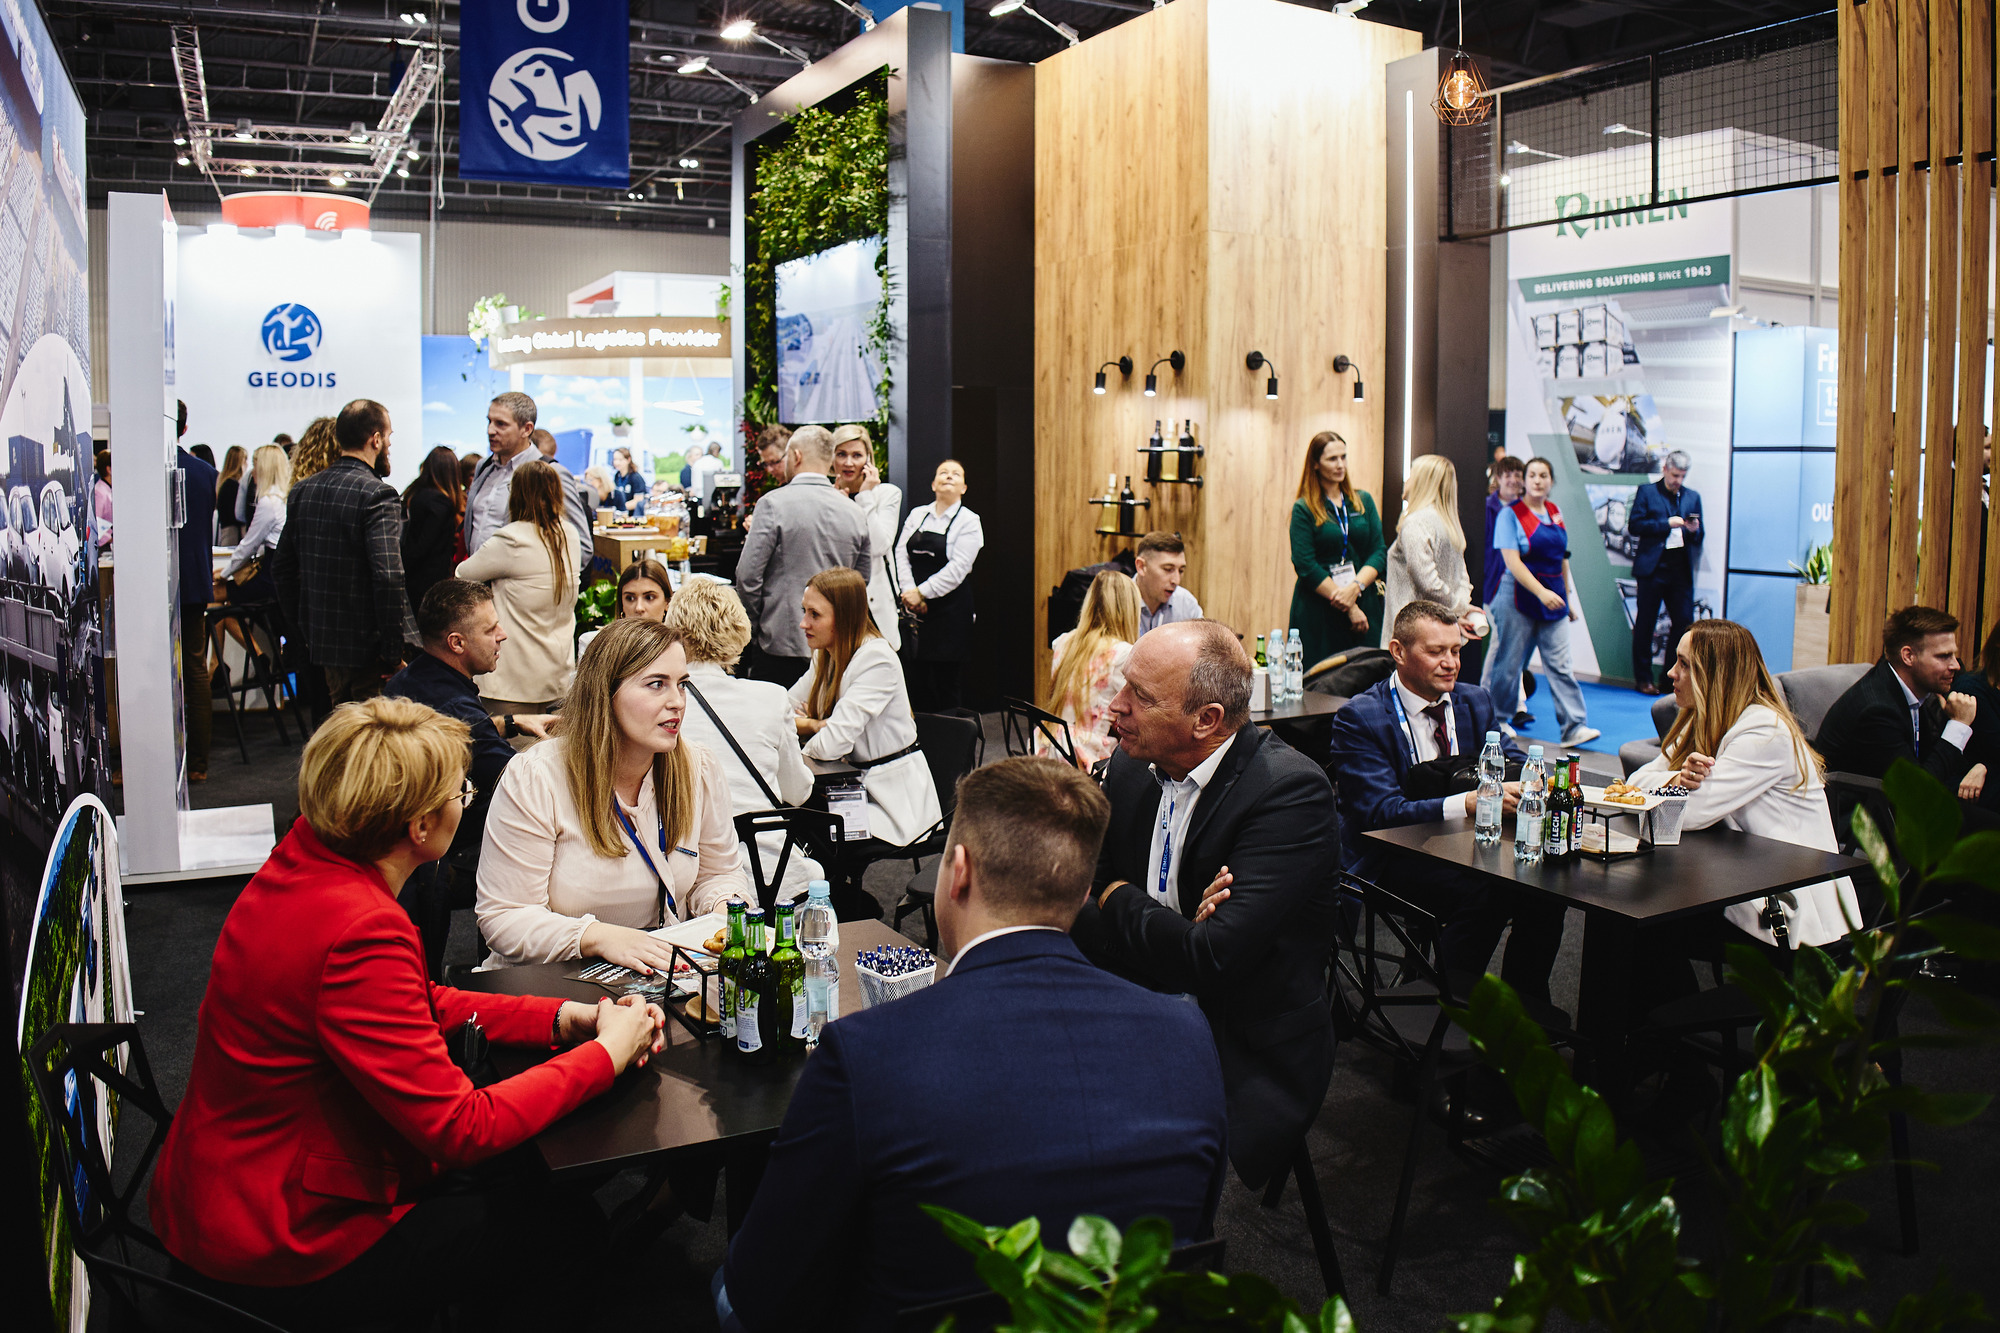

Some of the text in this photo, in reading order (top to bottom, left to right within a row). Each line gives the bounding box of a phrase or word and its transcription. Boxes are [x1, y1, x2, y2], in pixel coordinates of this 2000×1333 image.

[1555, 187, 1688, 239] RINNEN
[1533, 264, 1712, 294] DELIVERING SOLUTIONS SINCE 1943
[532, 330, 575, 350] Global
[575, 328, 646, 351] Logistics
[648, 328, 722, 348] Provider
[248, 372, 337, 388] GEODIS
[1811, 502, 1833, 522] OU
